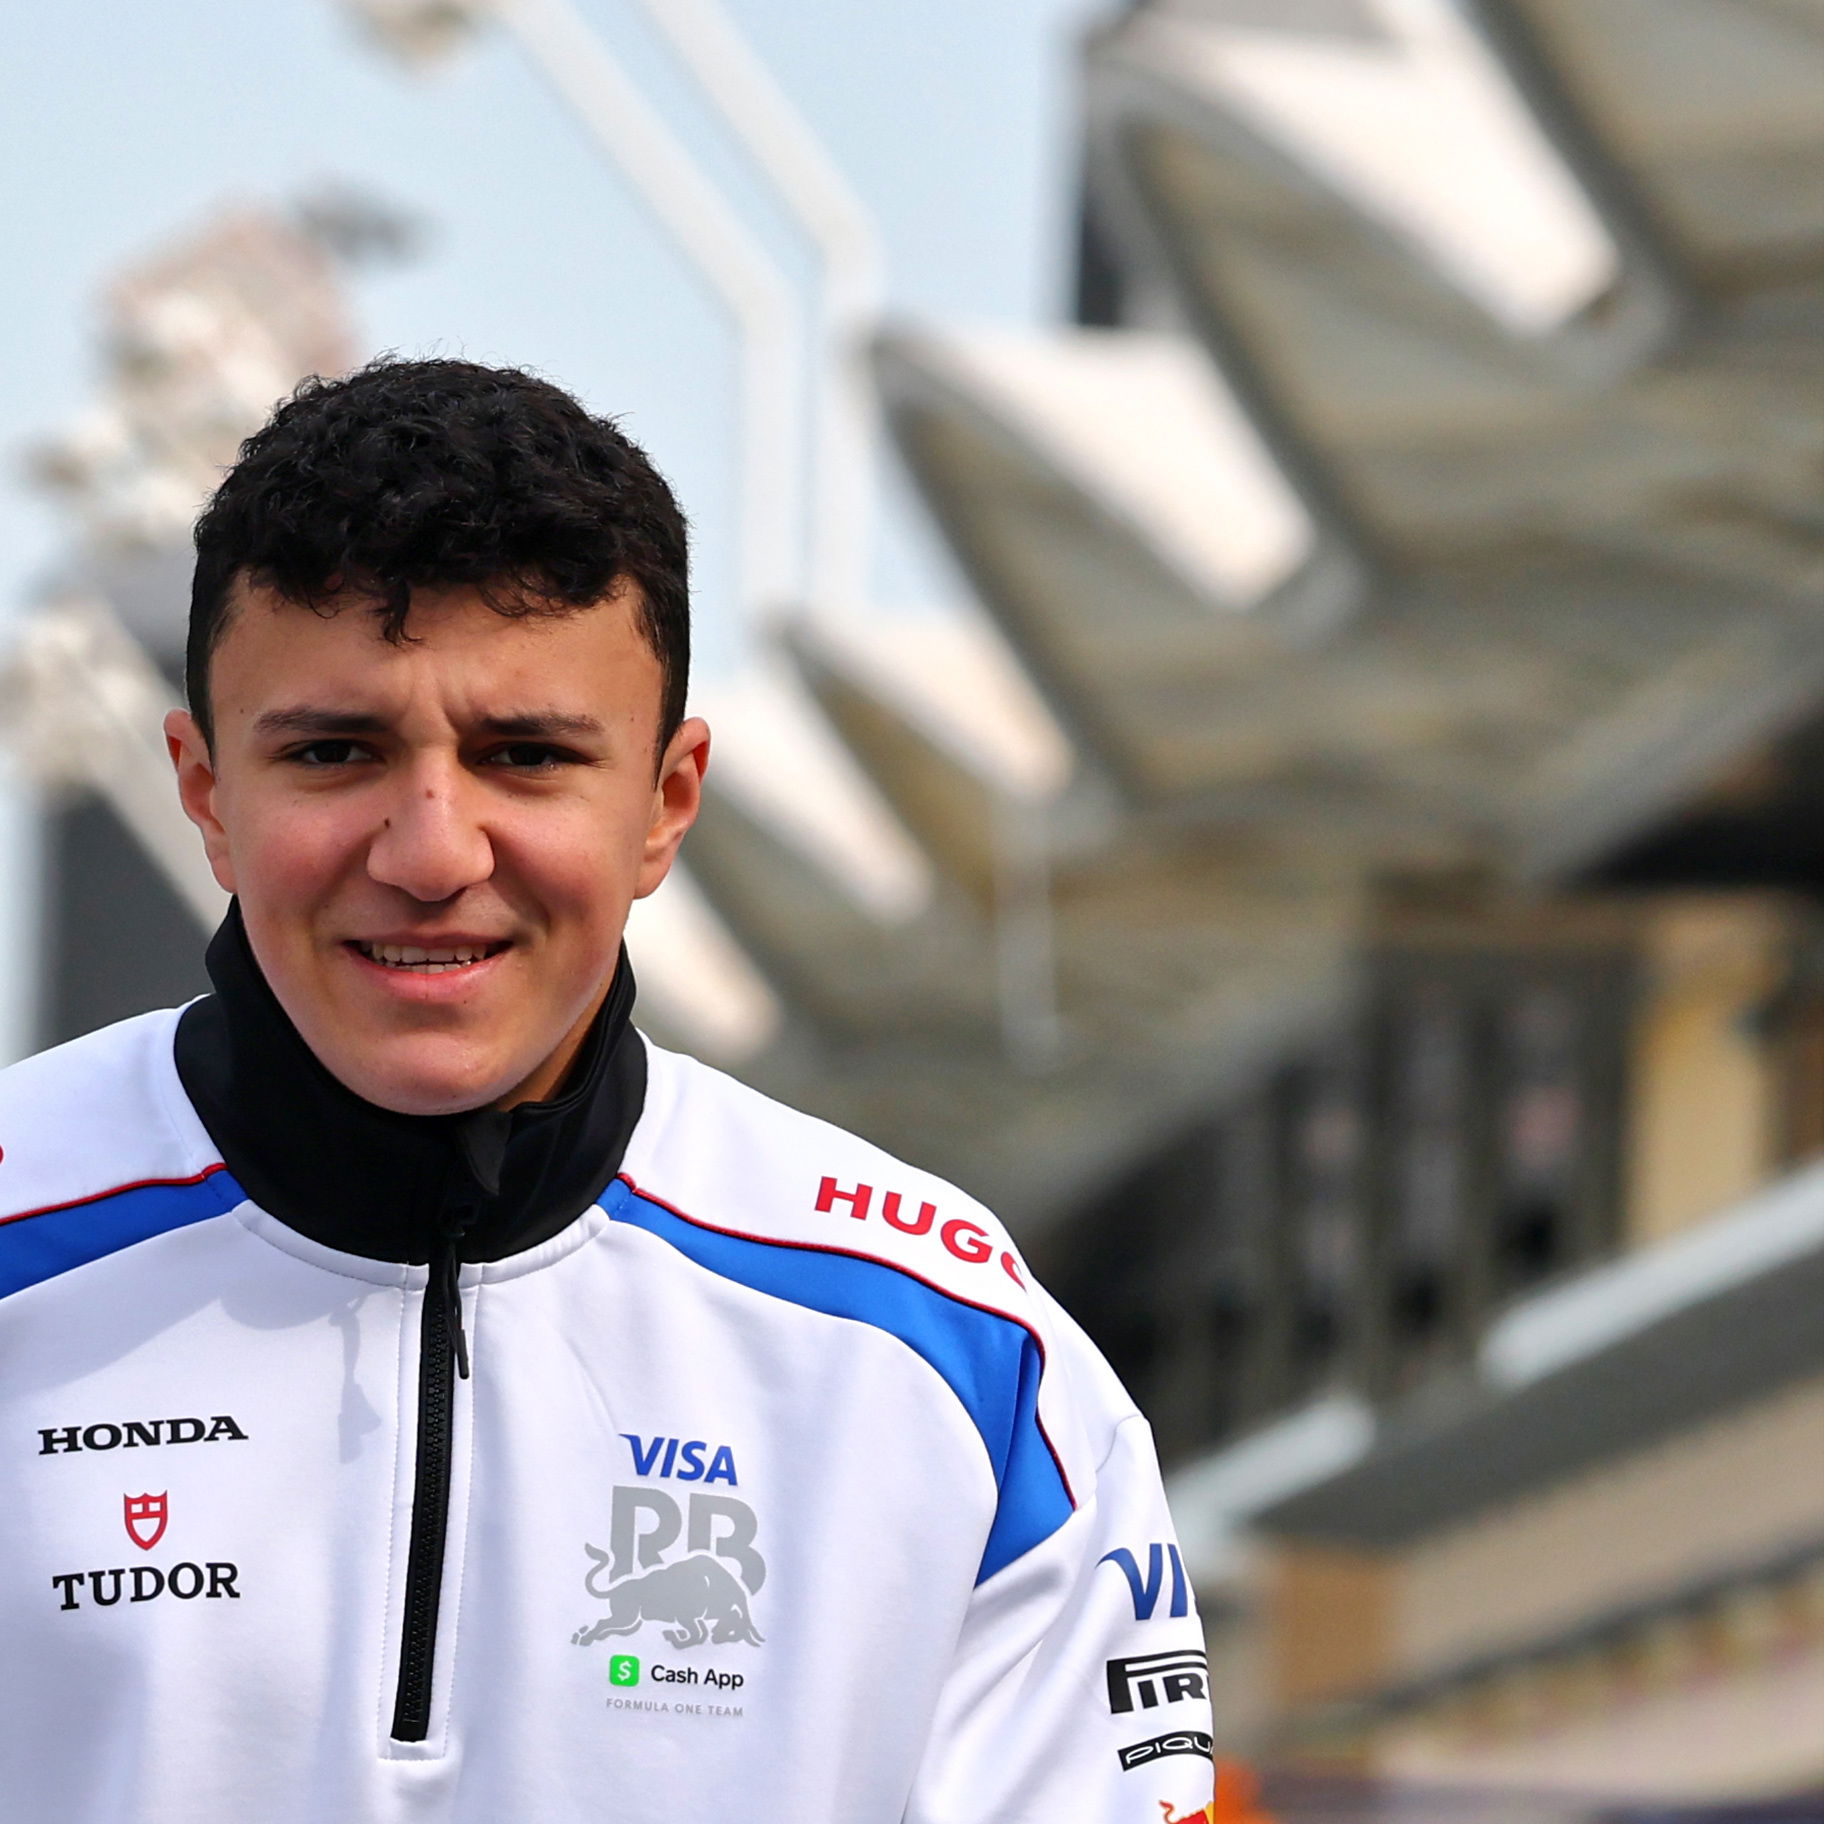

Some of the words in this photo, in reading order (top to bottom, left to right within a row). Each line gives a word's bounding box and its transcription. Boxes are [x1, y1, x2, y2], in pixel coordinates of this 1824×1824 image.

[37, 1415, 249, 1455] HONDA
[618, 1434, 738, 1486] VISA
[52, 1562, 240, 1611] TUDOR
[651, 1664, 698, 1684] Cash
[704, 1668, 744, 1690] App
[606, 1698, 669, 1713] FORMULA
[674, 1703, 702, 1715] ONE
[707, 1705, 744, 1717] TEAM
